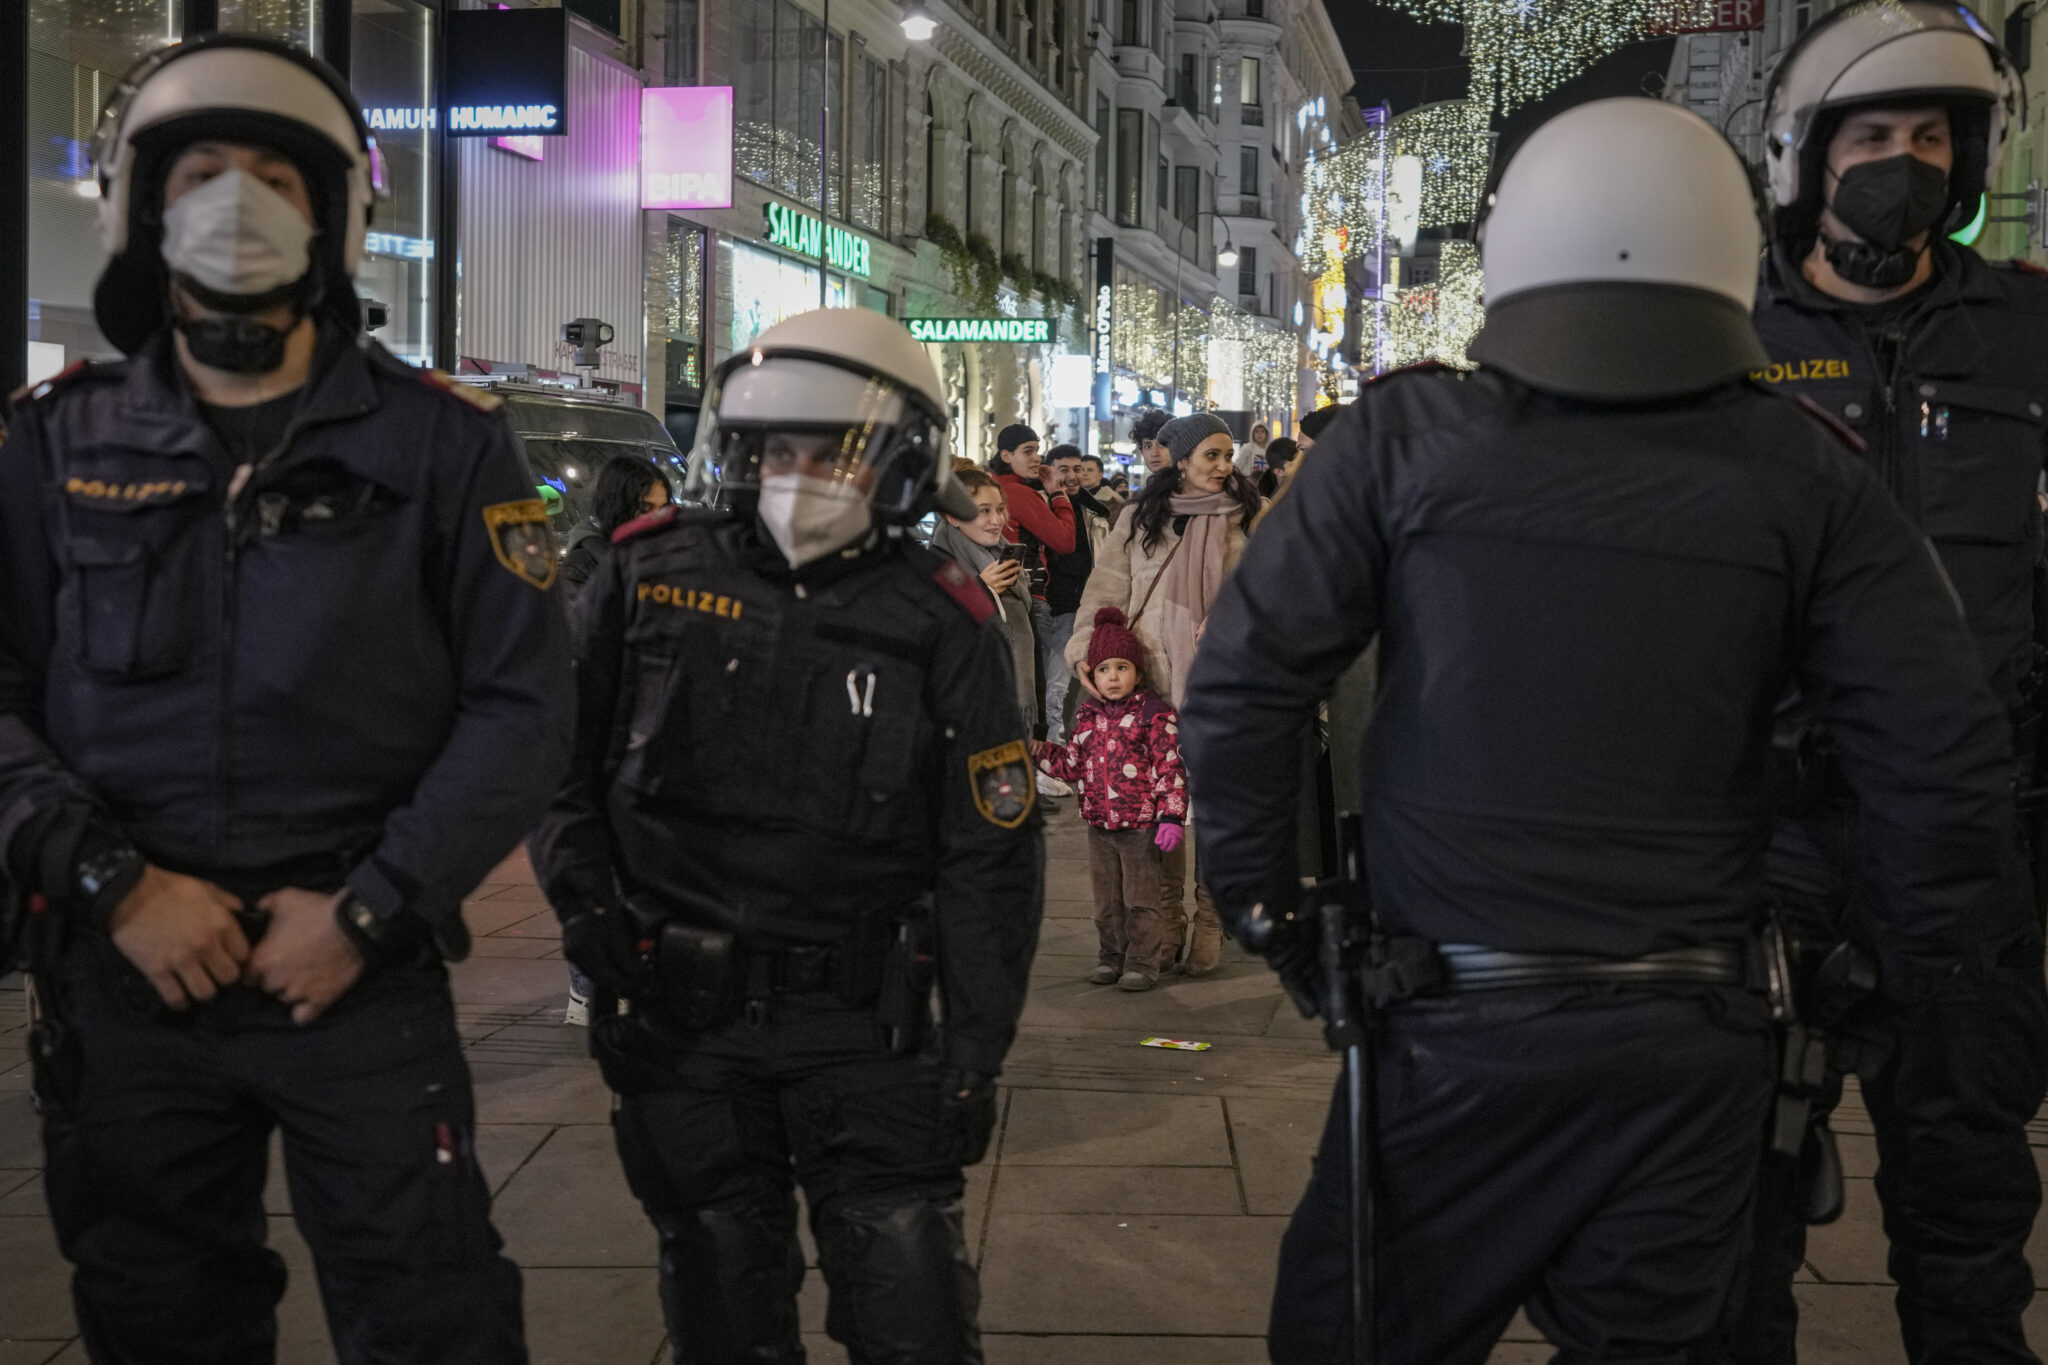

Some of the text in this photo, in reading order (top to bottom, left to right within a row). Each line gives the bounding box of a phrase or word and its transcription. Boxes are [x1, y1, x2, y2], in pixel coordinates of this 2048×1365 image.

[451, 105, 557, 130] HUMANIC
[648, 173, 724, 201] BIPA
[768, 201, 871, 276] SALAMANDER
[909, 319, 1049, 342] SALAMANDER
[637, 583, 743, 621] POLIZEI
